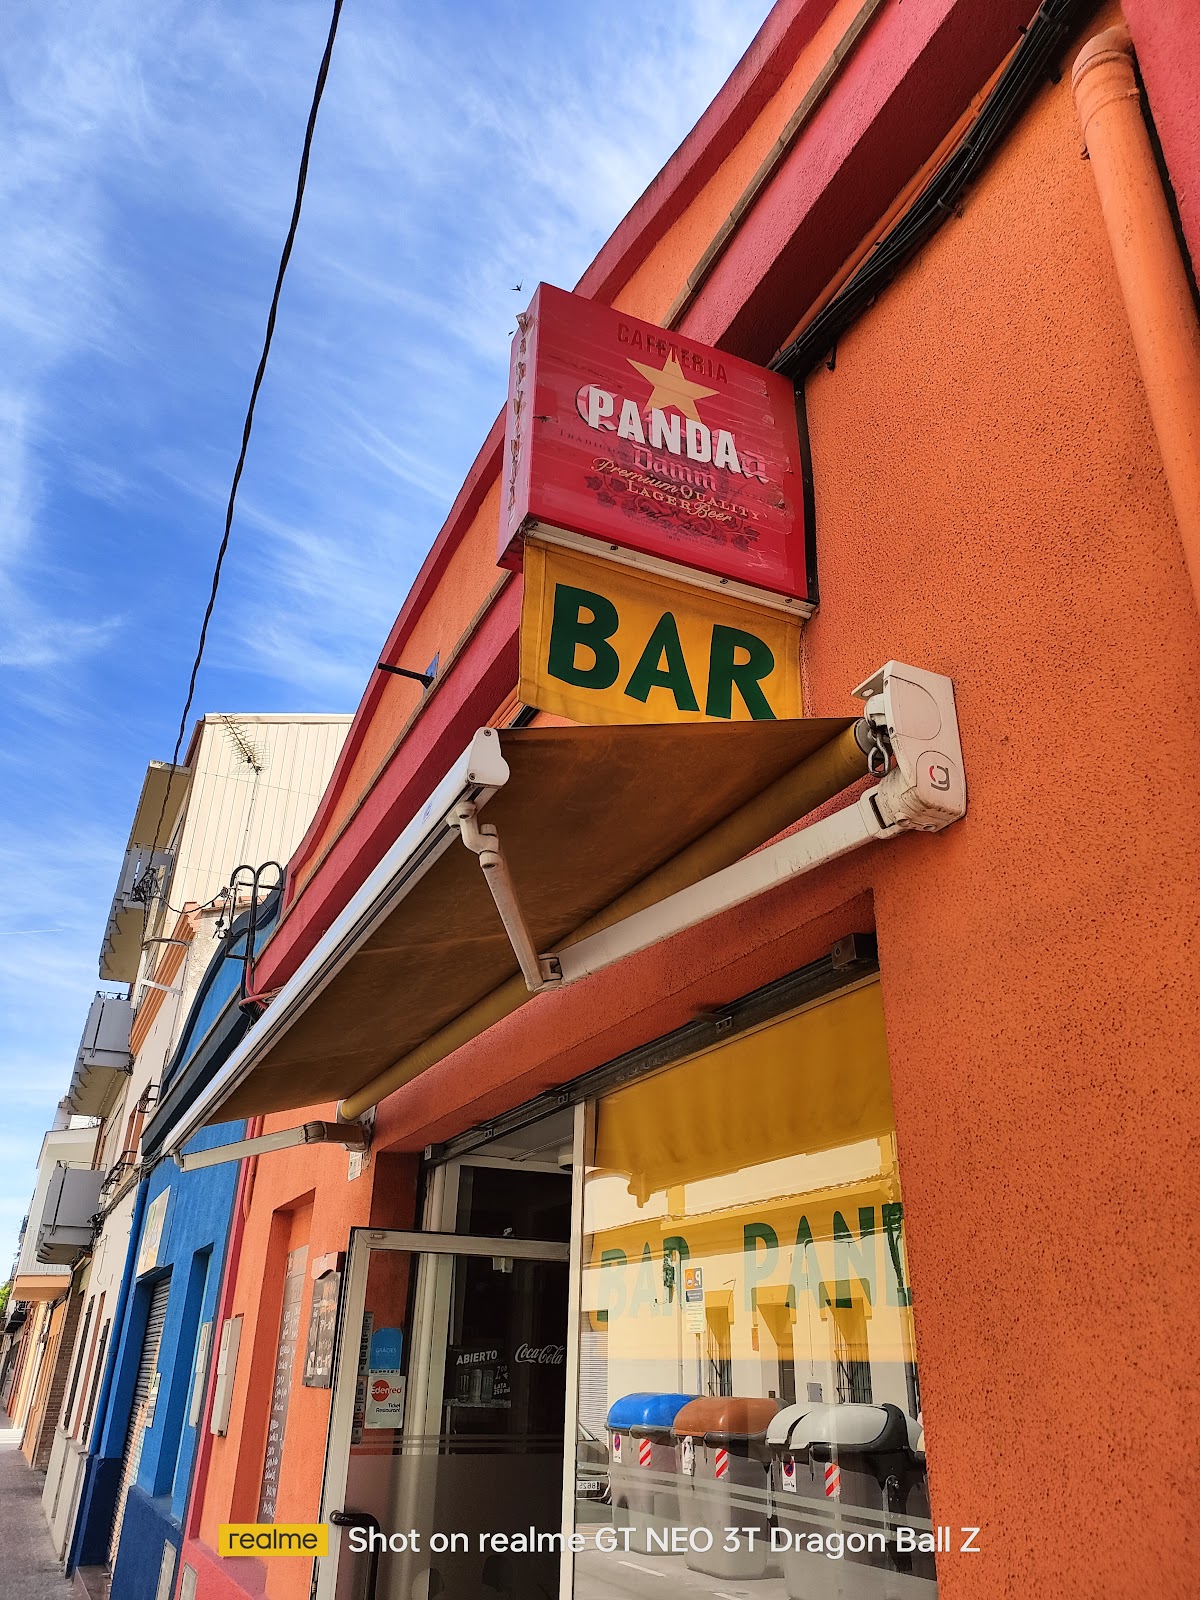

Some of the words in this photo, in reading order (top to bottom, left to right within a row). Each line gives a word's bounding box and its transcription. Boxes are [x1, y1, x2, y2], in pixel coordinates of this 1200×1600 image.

[617, 323, 728, 384] CAFETERIA
[588, 385, 741, 474] PANDA
[590, 456, 679, 494] Premium
[680, 484, 760, 521] QUALITY
[631, 443, 718, 492] Damm
[627, 480, 692, 512] LAGER
[687, 501, 734, 523] Beer
[547, 583, 777, 721] BAR
[597, 1236, 691, 1321] BAR
[456, 1350, 498, 1365] ABIERTO
[515, 1343, 566, 1365] Coca-Cola
[371, 1386, 402, 1395] Edenred
